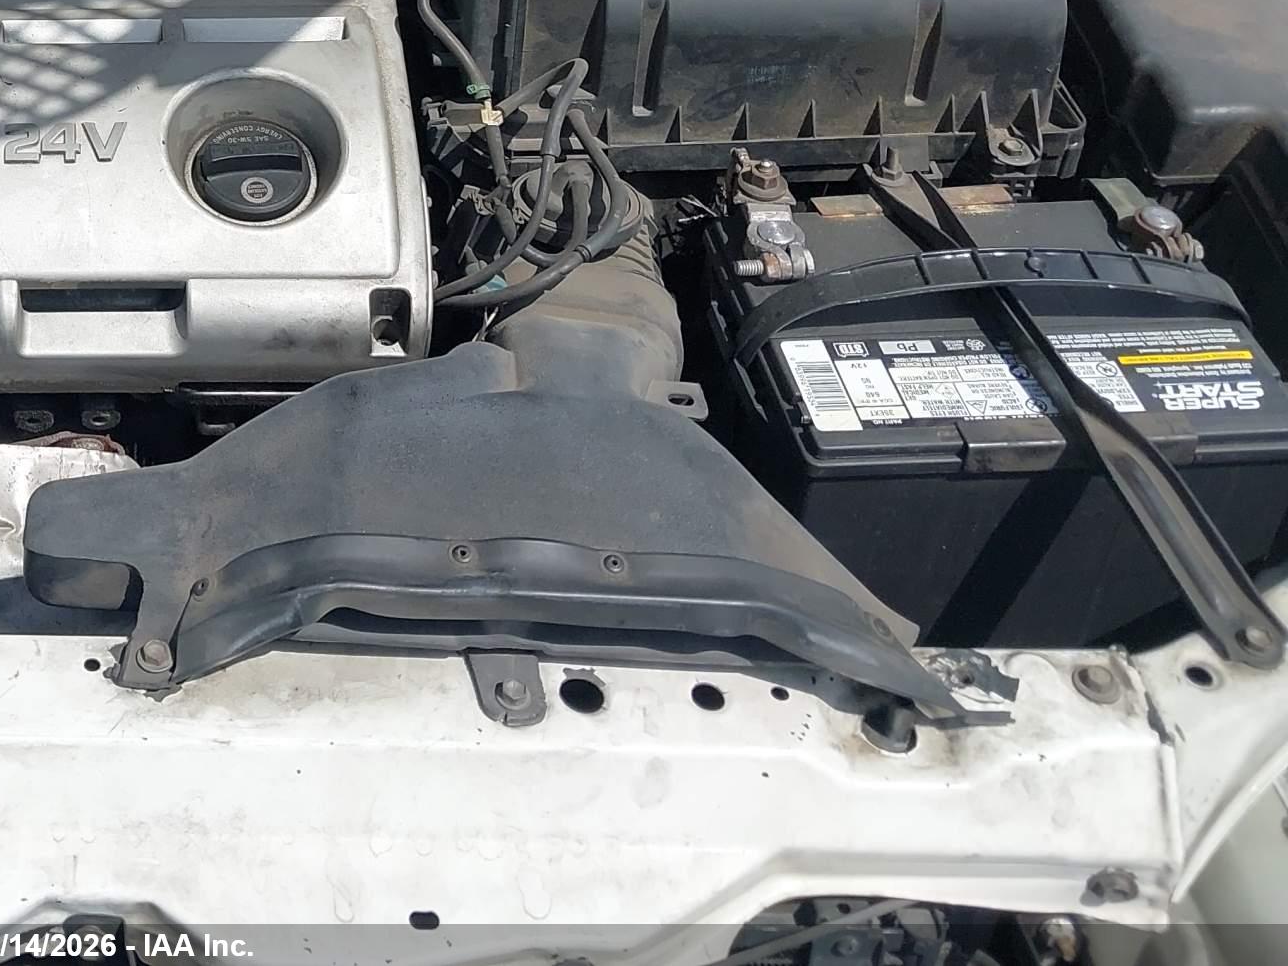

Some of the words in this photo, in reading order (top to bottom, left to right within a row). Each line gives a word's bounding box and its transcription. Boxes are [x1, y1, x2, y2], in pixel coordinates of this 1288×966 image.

[3, 121, 128, 164] 24V
[838, 344, 864, 355] STD
[896, 342, 918, 352] Pb
[1159, 381, 1264, 398] START
[1163, 395, 1260, 410] SUPER
